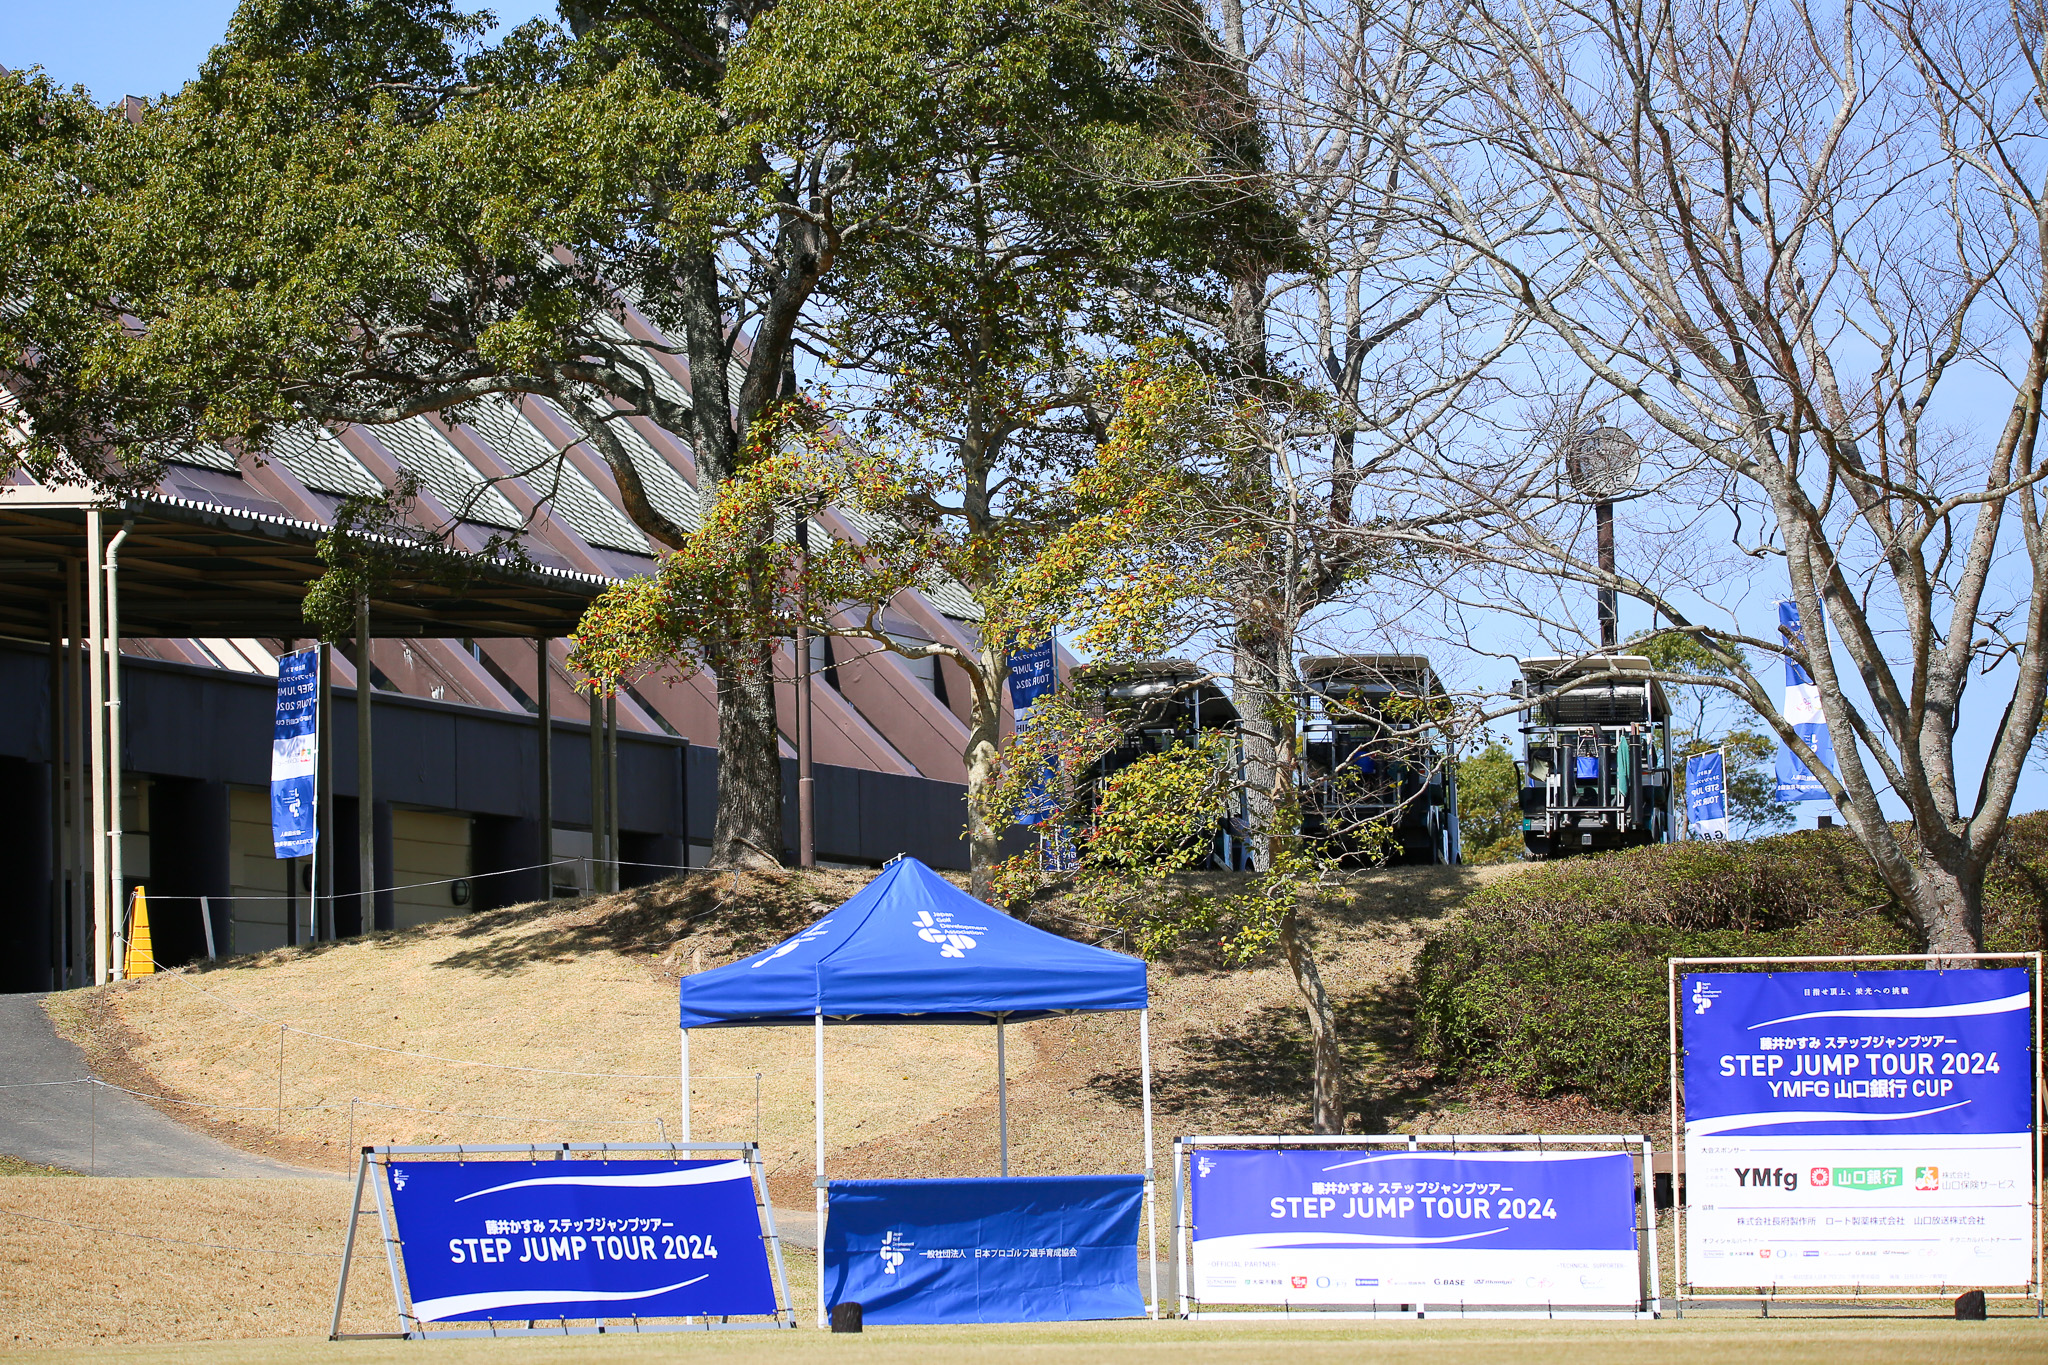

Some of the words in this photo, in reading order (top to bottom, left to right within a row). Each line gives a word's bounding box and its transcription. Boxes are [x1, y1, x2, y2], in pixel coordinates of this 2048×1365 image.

[939, 923, 989, 931] Development
[1760, 1036, 1821, 1050] 藤井かすみ
[1824, 1035, 1957, 1049] ステップジャンプツアー
[1719, 1054, 1784, 1077] STEP
[1789, 1053, 1859, 1076] JUMP
[1866, 1052, 1935, 1075] TOUR
[1941, 1051, 2000, 1075] 2024
[1767, 1080, 1830, 1098] YMFG
[1833, 1078, 1907, 1099] 山口銀行
[1912, 1078, 1953, 1097] CUP
[1734, 1167, 1798, 1192] YMfg
[1838, 1169, 1898, 1185] 山口銀行
[1942, 1179, 2016, 1190] 山口保険サービス
[1312, 1182, 1374, 1196] 藤井かすみ
[1378, 1181, 1514, 1196] ステップジャンプツアー
[1270, 1196, 1336, 1219] STEP
[1343, 1196, 1415, 1219] JUMP
[1421, 1197, 1491, 1219] TOUR
[1498, 1198, 1557, 1220] 2024
[485, 1219, 545, 1235] 藤井かすみ
[548, 1217, 674, 1233] ステップジャンプツアー
[1737, 1217, 1816, 1226] 株式会社長府製作所
[1825, 1216, 1905, 1226] ロート製薬株式会社
[1914, 1216, 1985, 1225] 山口放送株式会社
[449, 1237, 512, 1264] STEP
[519, 1235, 587, 1263] JUMP
[591, 1235, 658, 1261] TOUR
[661, 1234, 718, 1260] 2024
[918, 1248, 967, 1259] 一般社団法人
[974, 1247, 1078, 1258] 日本プロゴルフ選手育成協会
